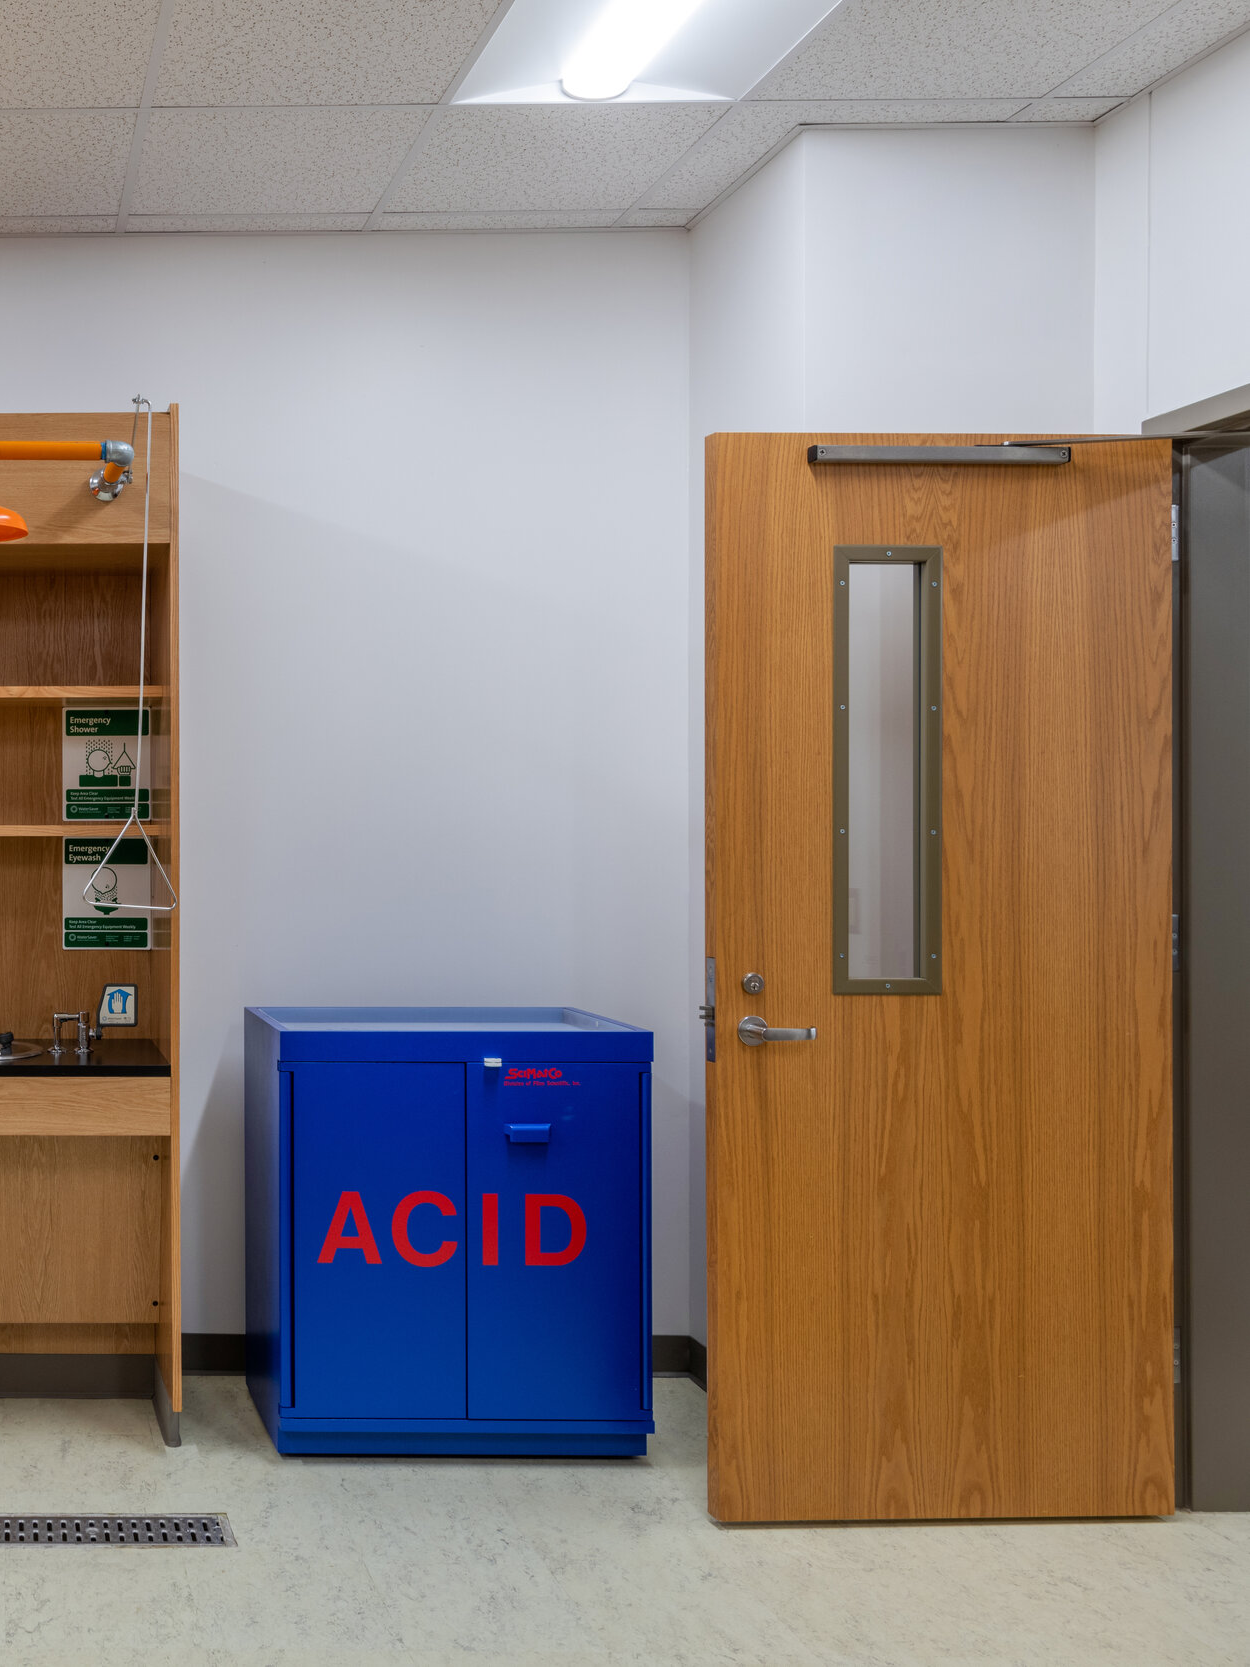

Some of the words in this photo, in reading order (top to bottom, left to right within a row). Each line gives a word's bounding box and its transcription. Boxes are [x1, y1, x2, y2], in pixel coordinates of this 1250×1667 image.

[70, 716, 111, 726] Emergency
[70, 725, 98, 733] Shower
[69, 844, 110, 853] Emergency
[69, 853, 101, 863] Eyewash
[316, 1190, 588, 1268] ACID
